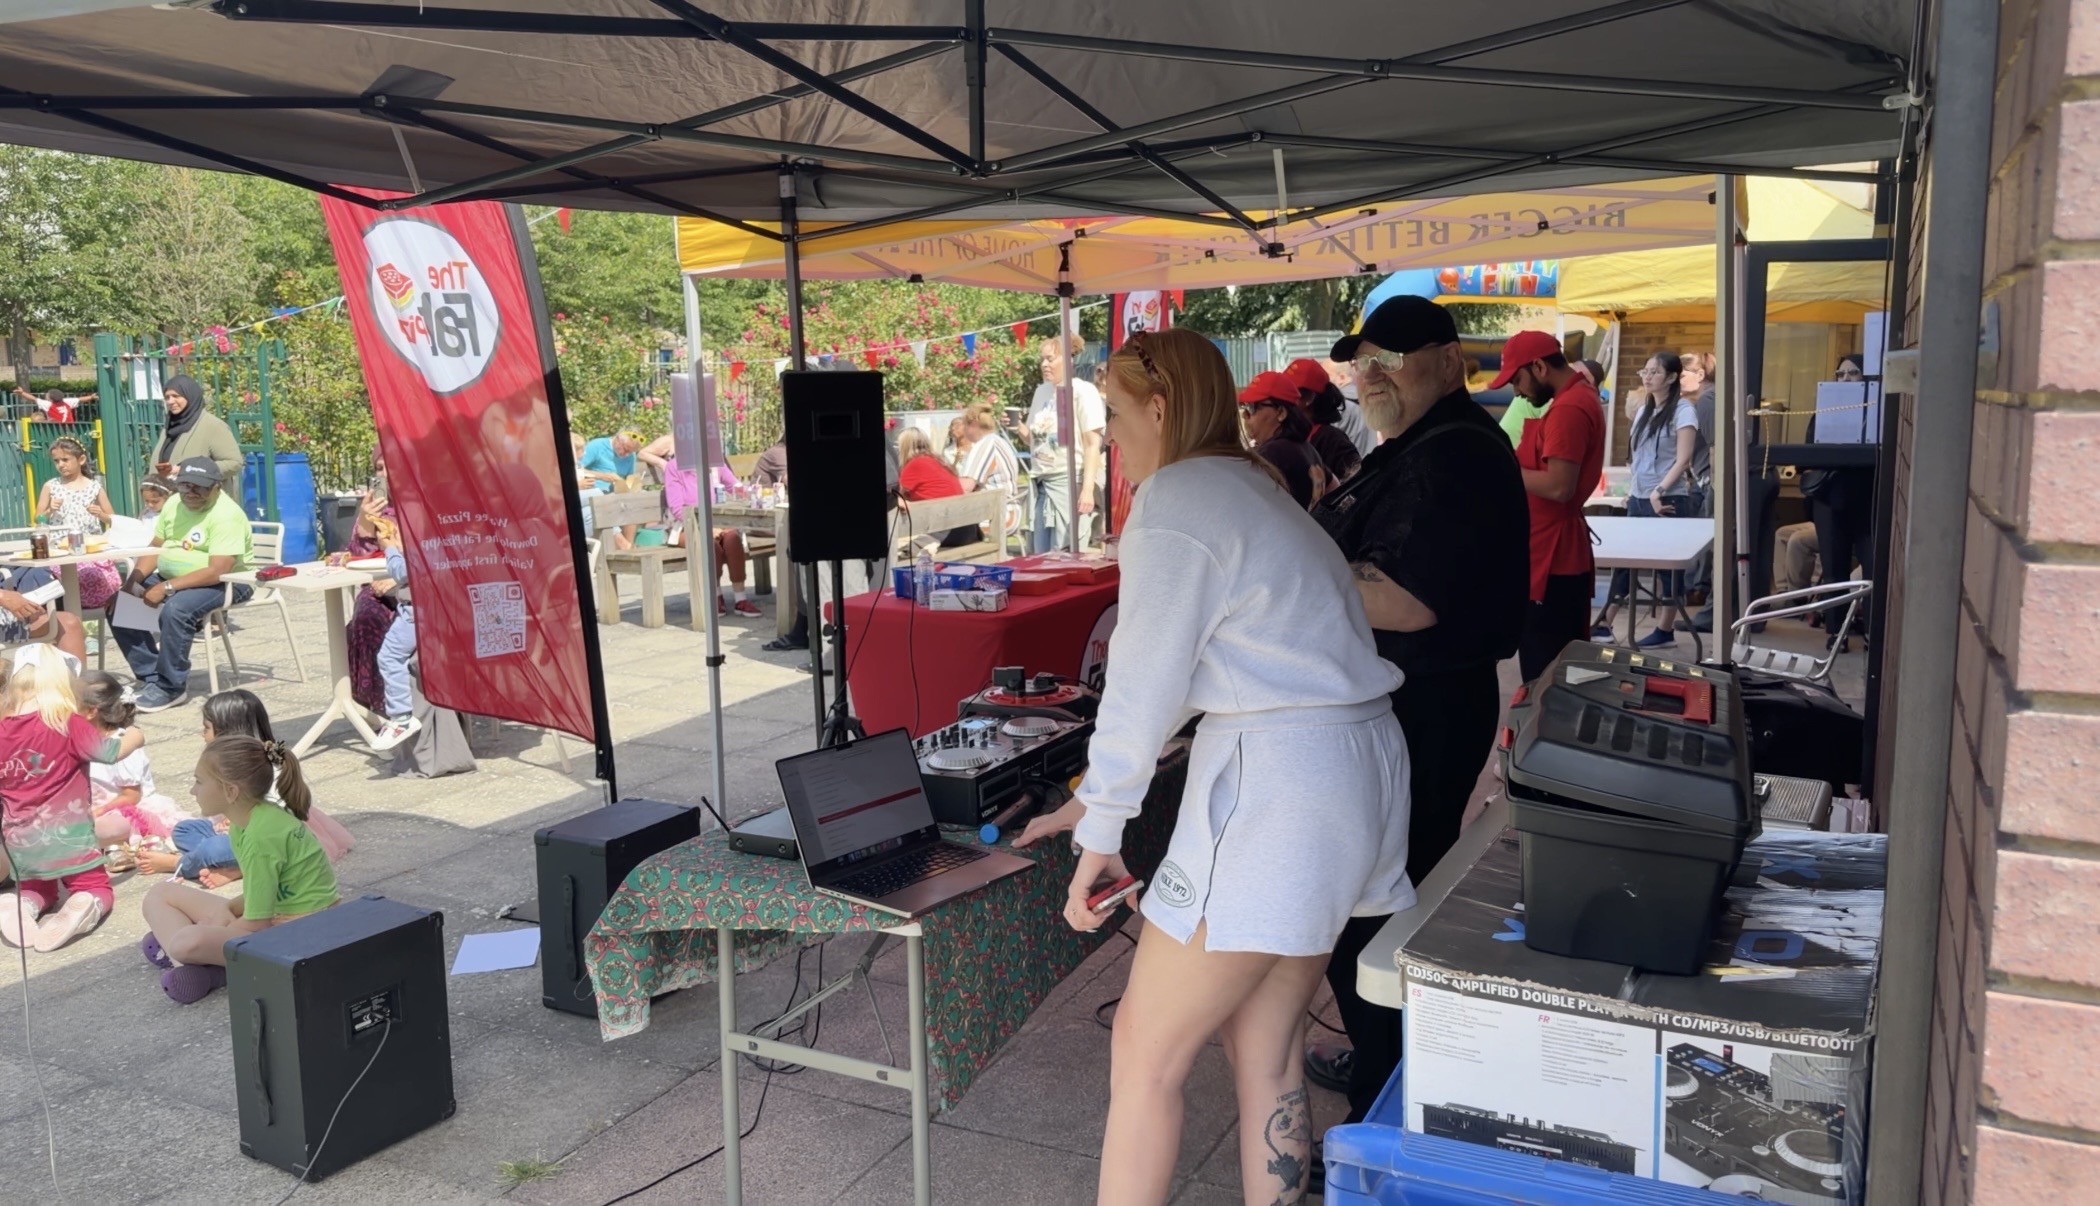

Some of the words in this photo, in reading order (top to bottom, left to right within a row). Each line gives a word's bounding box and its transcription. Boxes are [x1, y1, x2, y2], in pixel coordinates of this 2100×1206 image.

[57, 405, 70, 423] 7
[1172, 882, 1188, 898] 1972
[1411, 988, 1422, 998] ES
[1452, 979, 1520, 1000] AMPLIFIED
[1521, 989, 1576, 1010] DOUBLE
[1538, 1014, 1551, 1024] FR
